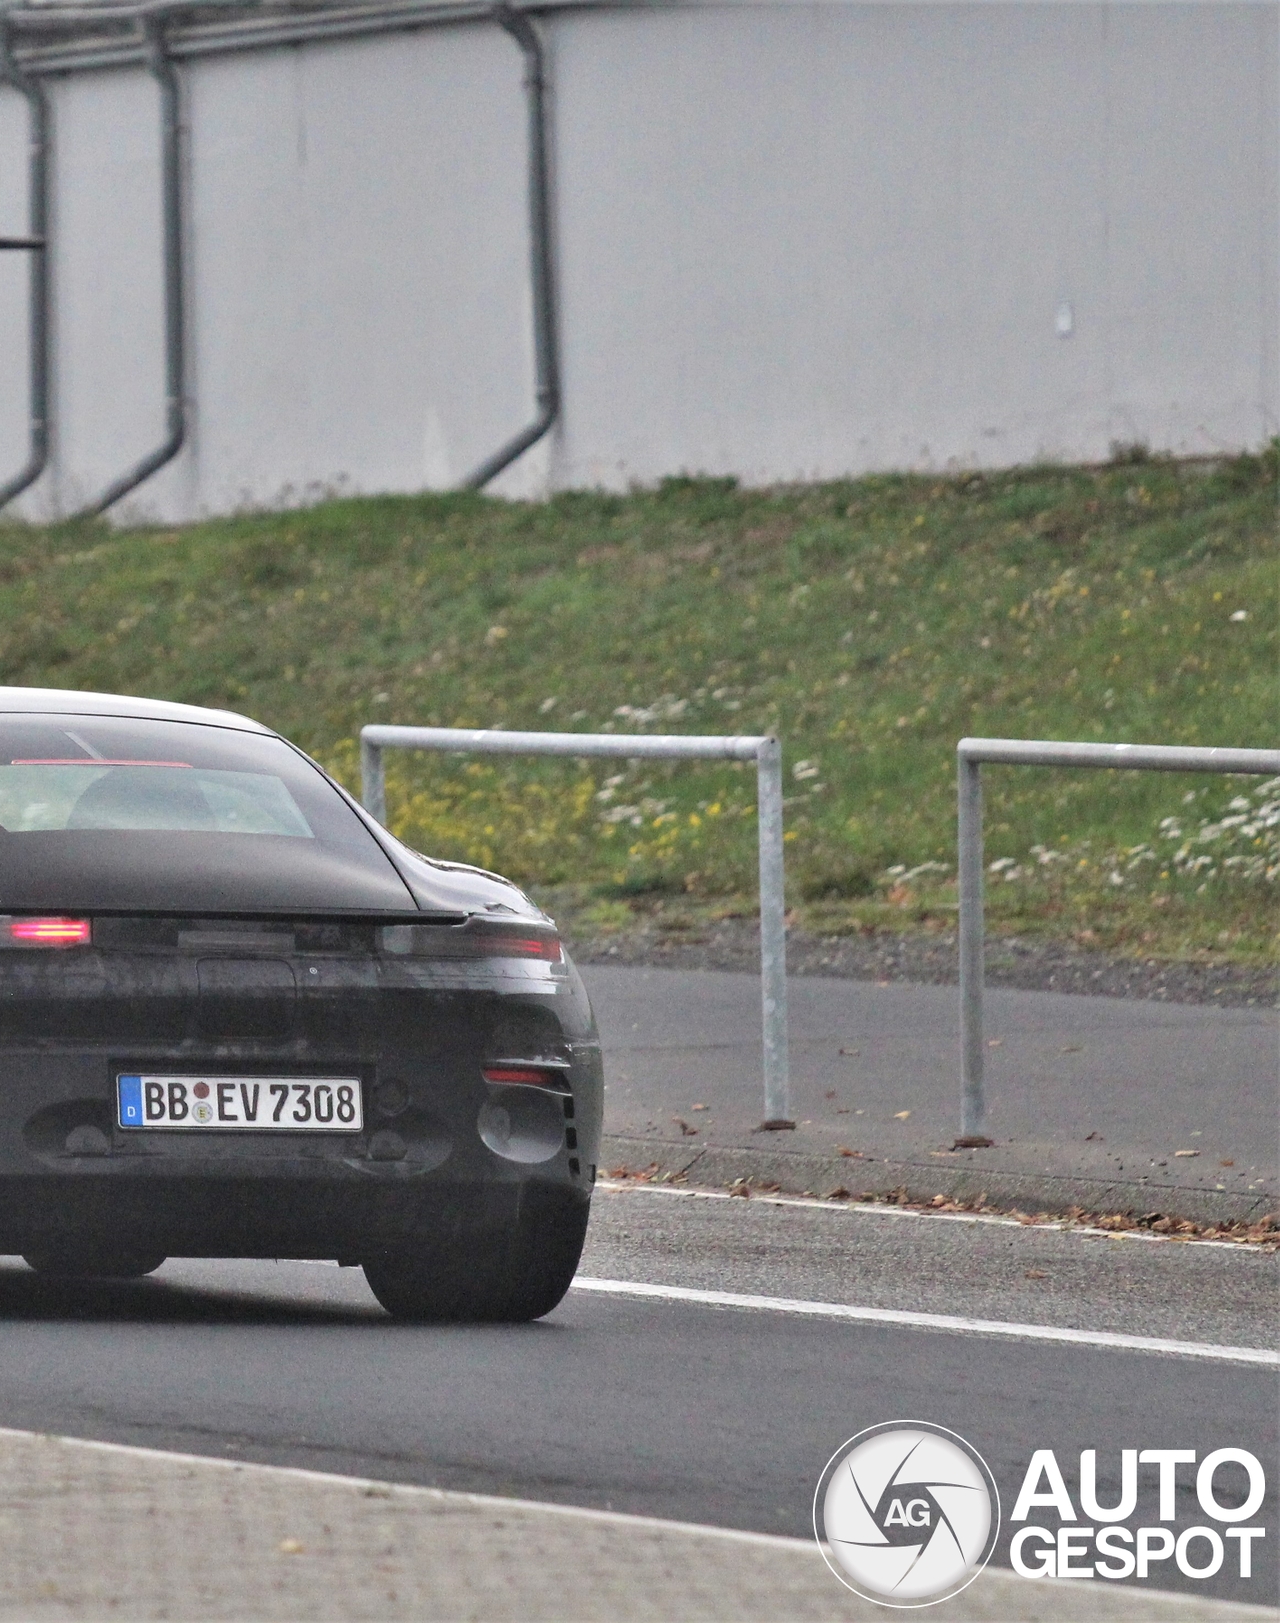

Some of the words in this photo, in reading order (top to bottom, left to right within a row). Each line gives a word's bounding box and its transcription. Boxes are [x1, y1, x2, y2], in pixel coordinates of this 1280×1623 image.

[126, 1105, 136, 1118] D
[144, 1082, 189, 1121] BB
[216, 1083, 260, 1122] EV
[269, 1084, 356, 1123] 7308
